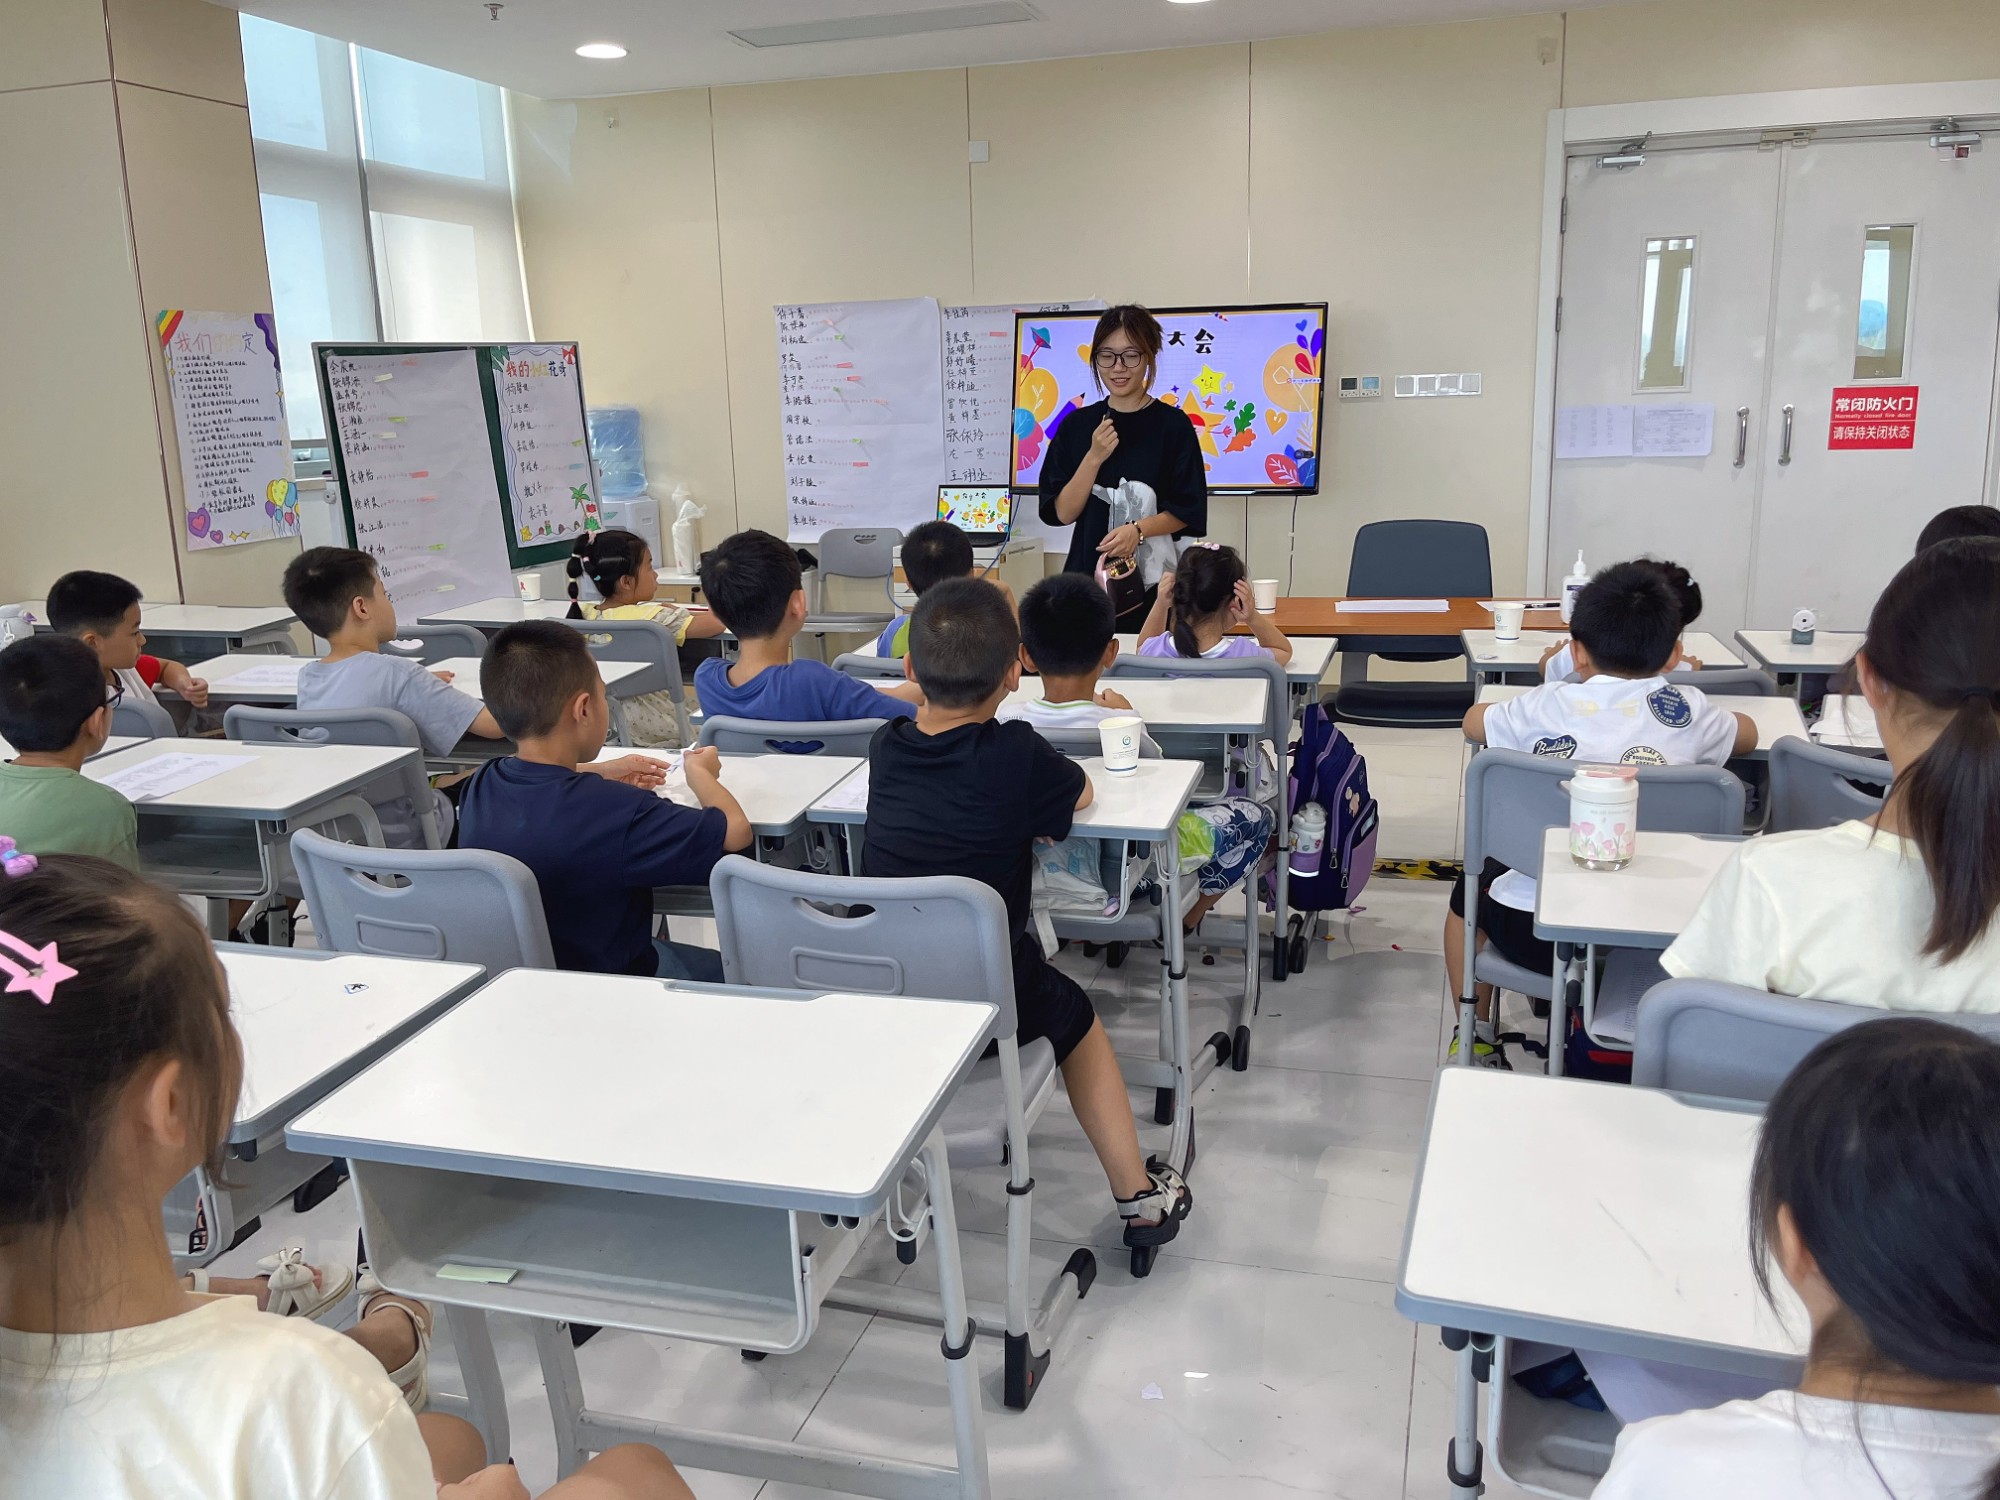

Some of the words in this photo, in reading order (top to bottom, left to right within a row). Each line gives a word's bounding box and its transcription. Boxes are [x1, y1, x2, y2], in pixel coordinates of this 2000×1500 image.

[1166, 328, 1215, 354] 大会
[1835, 397, 1914, 412] 常闭防火门
[1832, 426, 1911, 441] 请保持关闭状态
